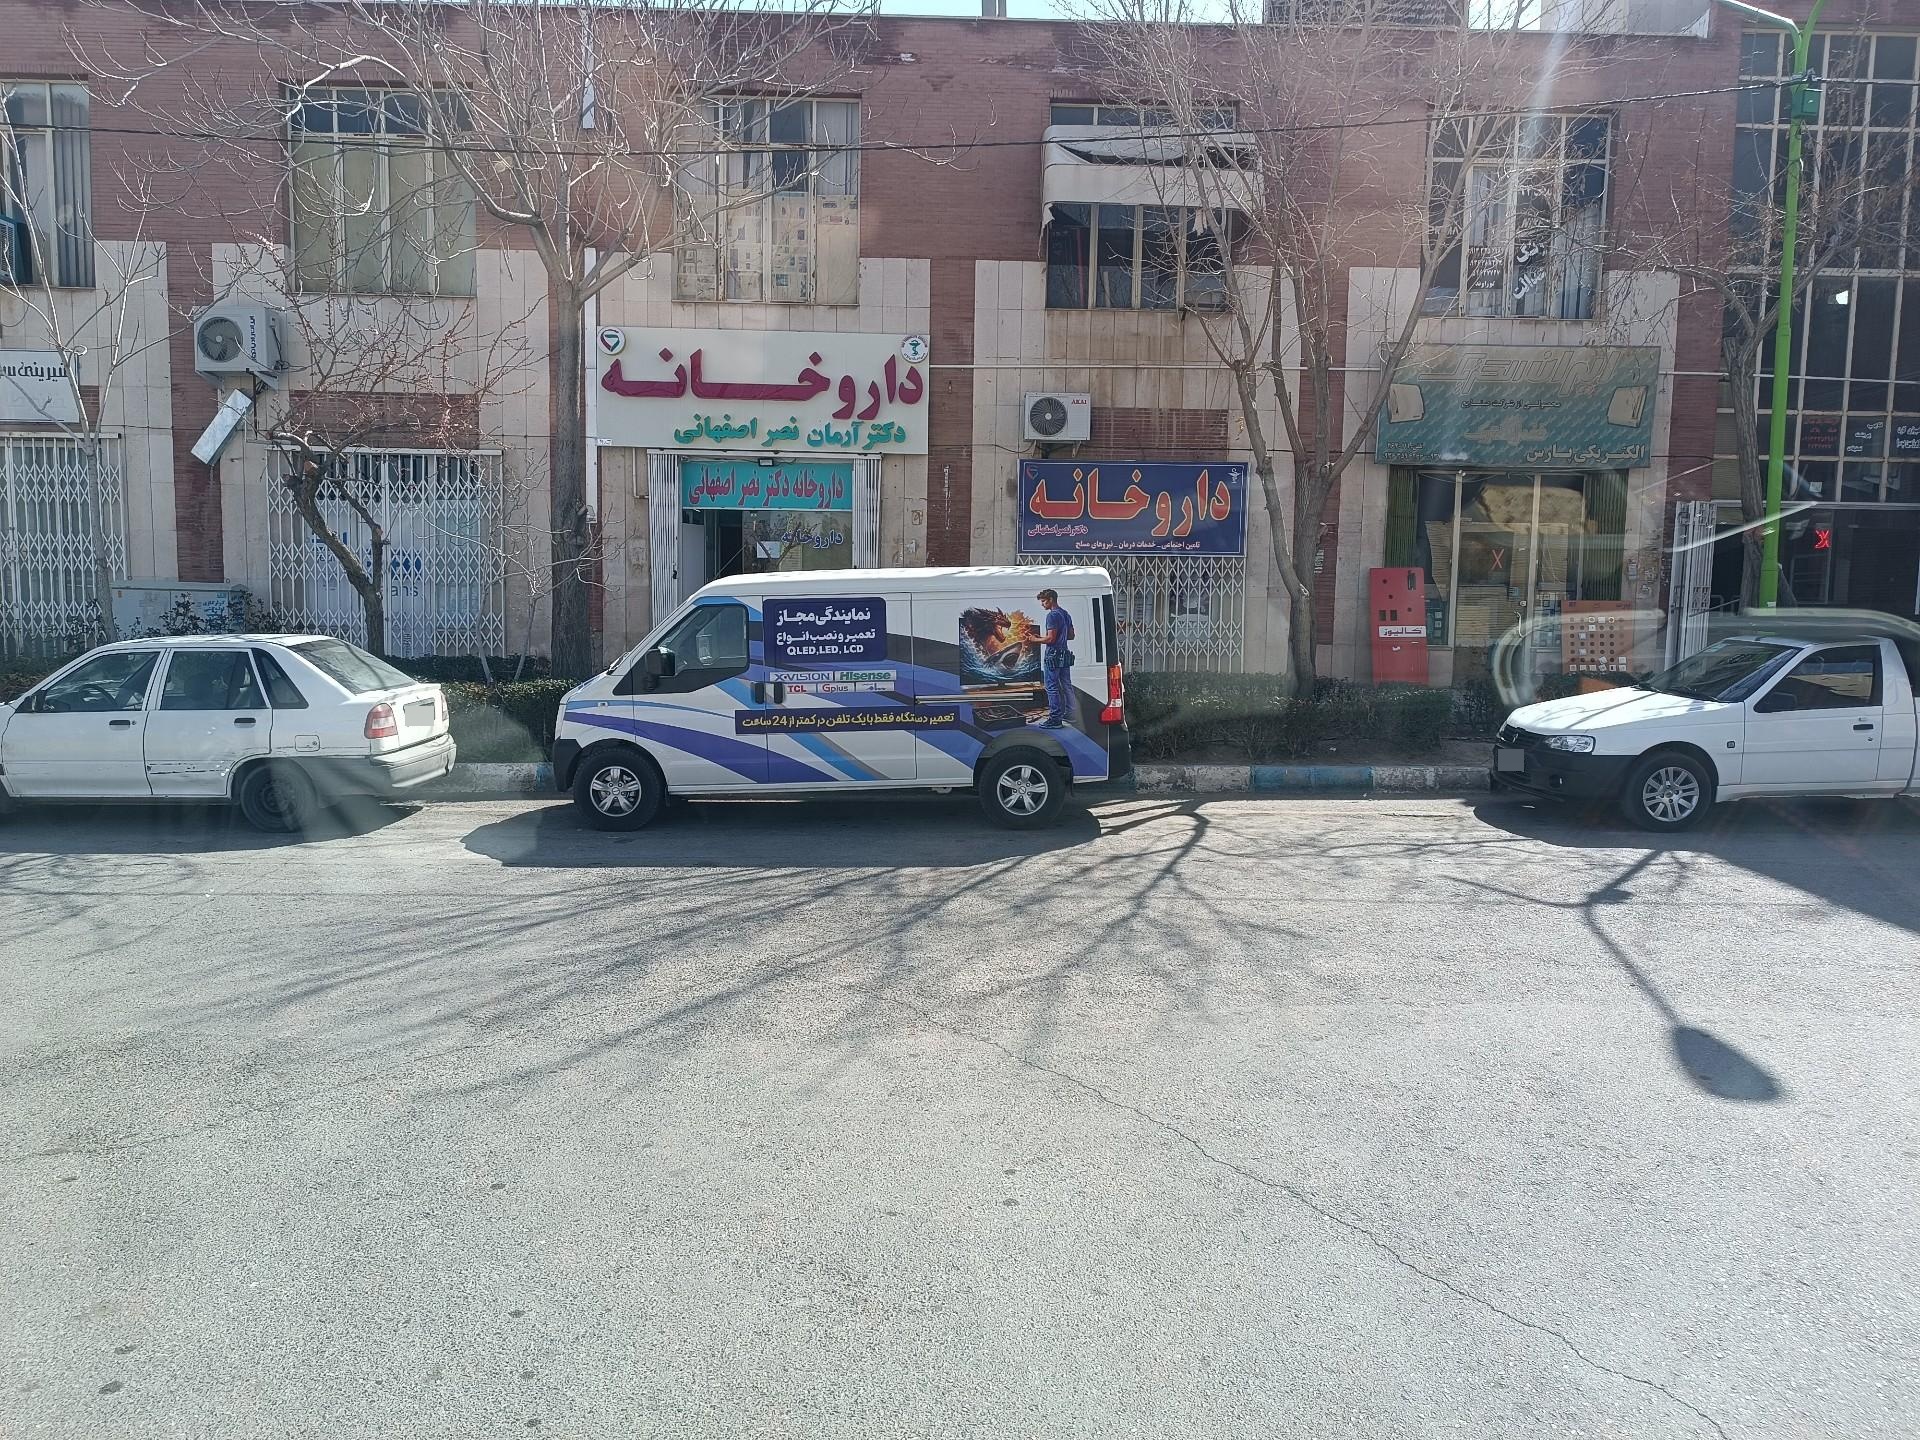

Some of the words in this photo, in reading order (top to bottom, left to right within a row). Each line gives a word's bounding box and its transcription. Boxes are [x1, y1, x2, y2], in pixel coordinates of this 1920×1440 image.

[601, 347, 924, 420] داروخانه
[674, 413, 757, 443] اصفهانی
[761, 416, 800, 447] نصر
[806, 421, 864, 448] آرمان
[863, 420, 906, 450] دکتر
[1526, 442, 1574, 463] پارس
[1574, 443, 1645, 464] الکتریکی
[688, 465, 736, 504] اصفهانی
[737, 470, 760, 506] نصر
[762, 469, 790, 507] دکتر
[793, 468, 844, 509] داروخانه
[1029, 467, 1231, 537] داروخانه
[781, 529, 844, 548] داروخانه
[1075, 540, 1090, 549] مسلح
[1091, 540, 1113, 549] نیروهای
[1118, 540, 1135, 550] درمان
[1136, 540, 1156, 549] خدمات
[1161, 541, 1184, 550] اجتماعی
[776, 608, 816, 626] مجاز
[815, 605, 871, 626] نمایندگی
[776, 630, 809, 646] انواع
[809, 630, 838, 644] نصب
[845, 628, 876, 643] تعمیر
[843, 644, 864, 654] LCD
[788, 685, 808, 694] TCL
[742, 716, 772, 727] ساعت
[772, 715, 787, 726] 24
[788, 715, 795, 728] از
[796, 713, 817, 727] کمتر
[816, 716, 825, 727] در
[825, 713, 850, 727] تلفن
[874, 712, 895, 724] فقط
[896, 711, 928, 724] دستگاه
[929, 712, 955, 725] تعمیر
